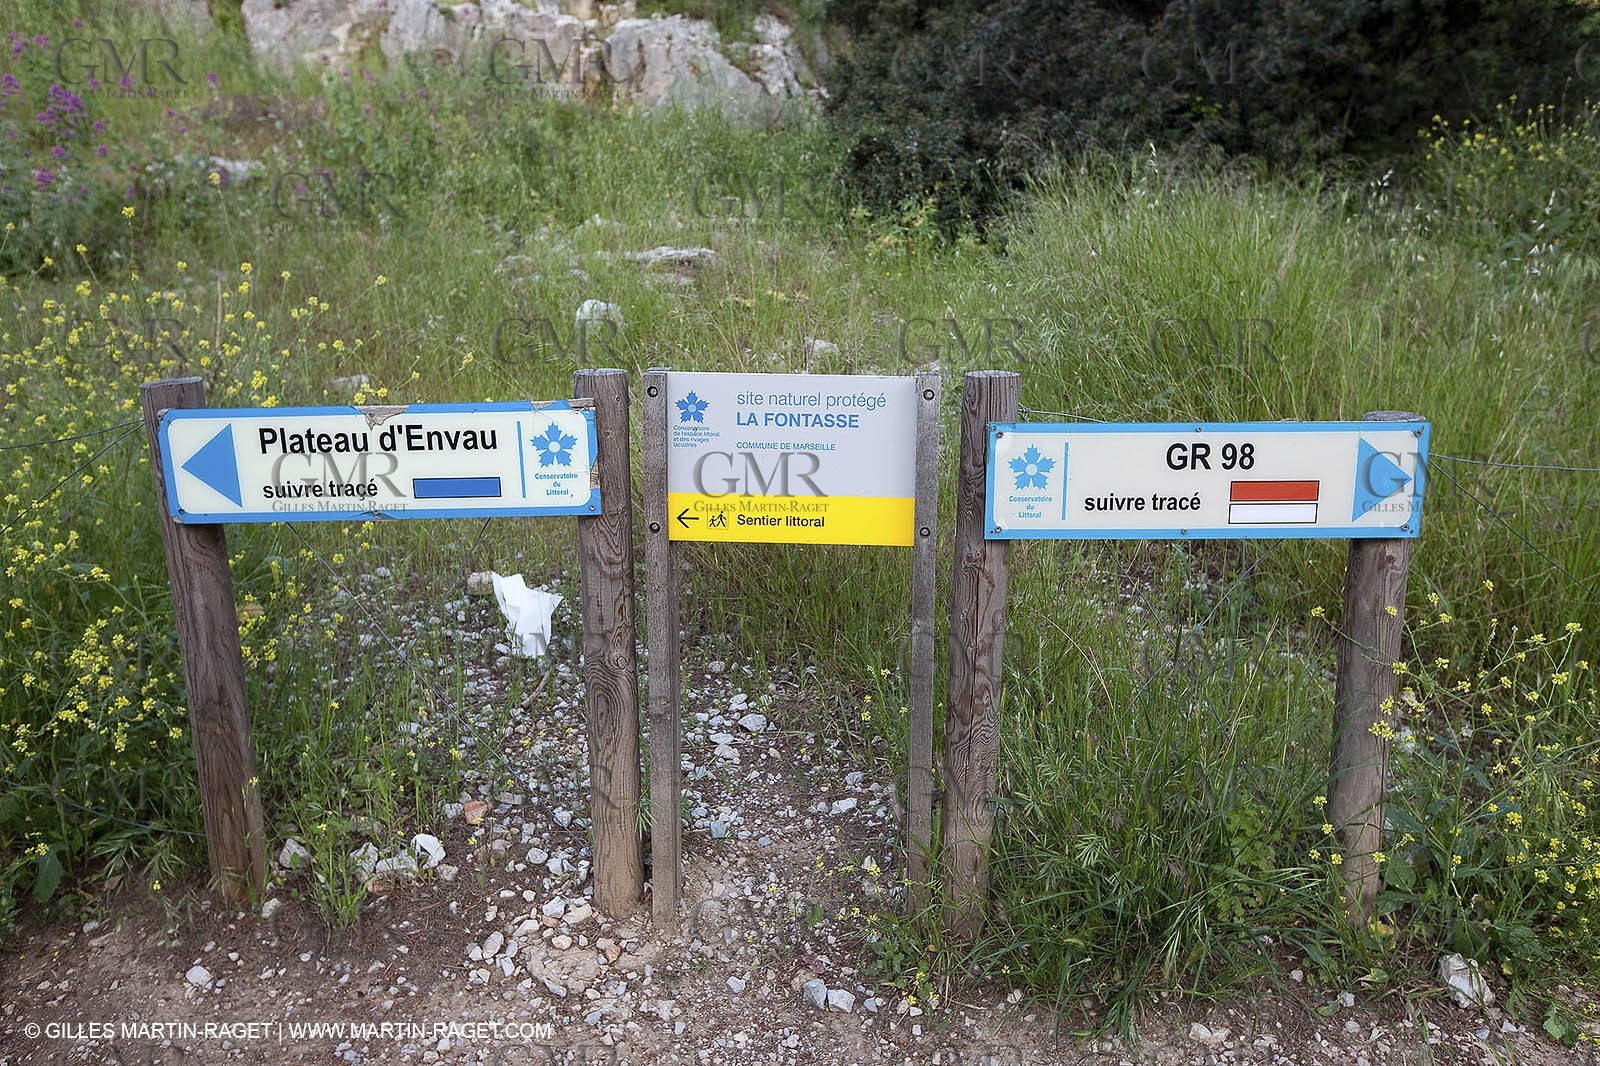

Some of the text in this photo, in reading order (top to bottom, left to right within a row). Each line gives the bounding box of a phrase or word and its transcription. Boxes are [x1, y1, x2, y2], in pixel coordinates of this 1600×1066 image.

[736, 391, 887, 411] site naturel protégé
[736, 412, 859, 429] LA FONTASSE
[259, 424, 498, 455] Plateau d'Envau
[736, 442, 836, 451] COMMUNE DE MARSEILLE
[1166, 442, 1256, 471] GR 98
[263, 478, 378, 501] suivre traçé
[546, 488, 569, 496] Littoral
[1008, 495, 1053, 503] Conservatoire
[1084, 492, 1202, 511] suivre tracé
[1026, 503, 1035, 511] du
[737, 514, 825, 528] Sentier littoral
[1018, 511, 1042, 519] Littoral
